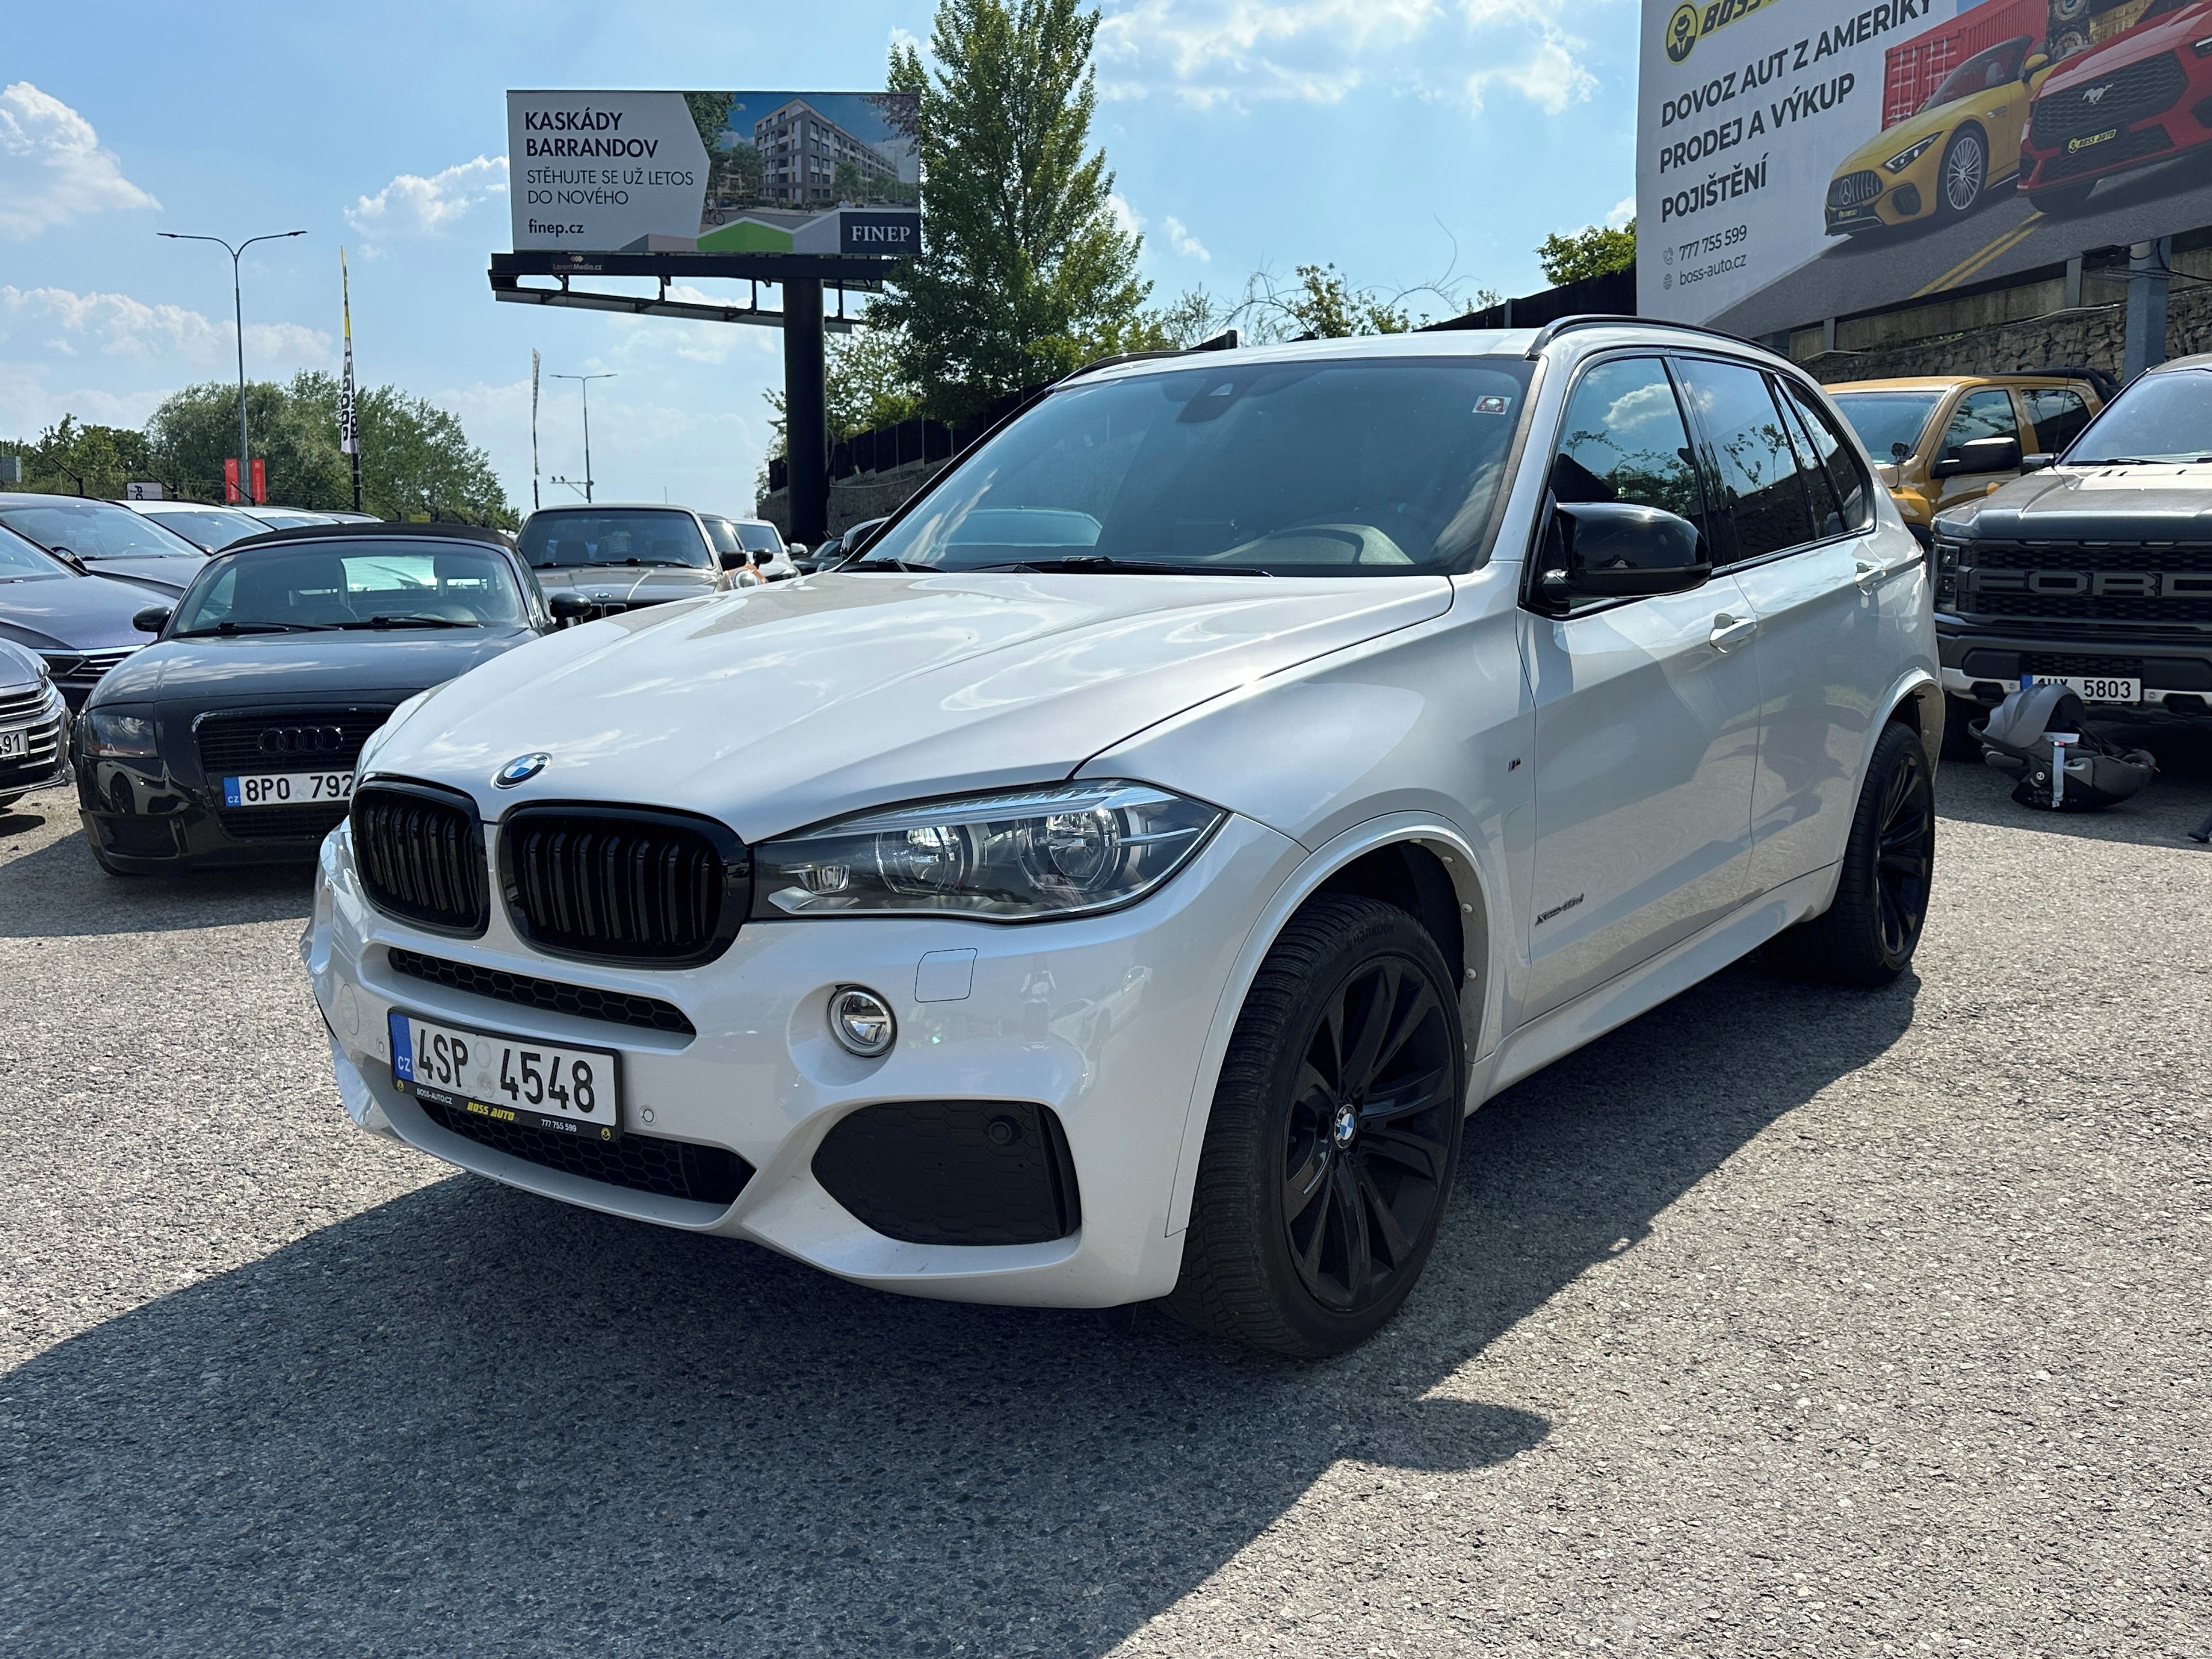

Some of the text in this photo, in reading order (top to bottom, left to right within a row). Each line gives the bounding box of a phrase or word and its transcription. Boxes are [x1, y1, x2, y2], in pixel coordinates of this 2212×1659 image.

[1662, 71, 1737, 128] DOVOZ
[1740, 48, 1788, 94] AUT
[1792, 40, 1809, 71] Z
[525, 106, 624, 131] KASKÁDY
[1660, 72, 1855, 174] PRODEJ A VÝKUP
[526, 138, 659, 159] BARRANDOV
[527, 166, 693, 185] STĚHUJTE SE UŽ LETOS
[1662, 151, 1769, 223] POJIŠTĚNÍ
[528, 187, 629, 205] DO NOVÉHO
[528, 218, 584, 238] finep.cz
[851, 225, 911, 242] FINEP
[1679, 224, 1747, 261] 777 755 599
[1679, 254, 1747, 286] boss-auto.cz
[1970, 568, 2212, 599] FORD
[2084, 679, 2131, 698] 5803
[0, 733, 20, 754] 91
[245, 777, 290, 802] 8P0
[398, 1029, 595, 1113] CZ 4SP 4548
[466, 1101, 489, 1116] BOSS
[490, 1107, 516, 1121] AUTO
[541, 1118, 551, 1128] 777
[552, 1121, 564, 1130] 755
[565, 1122, 577, 1132] 599
